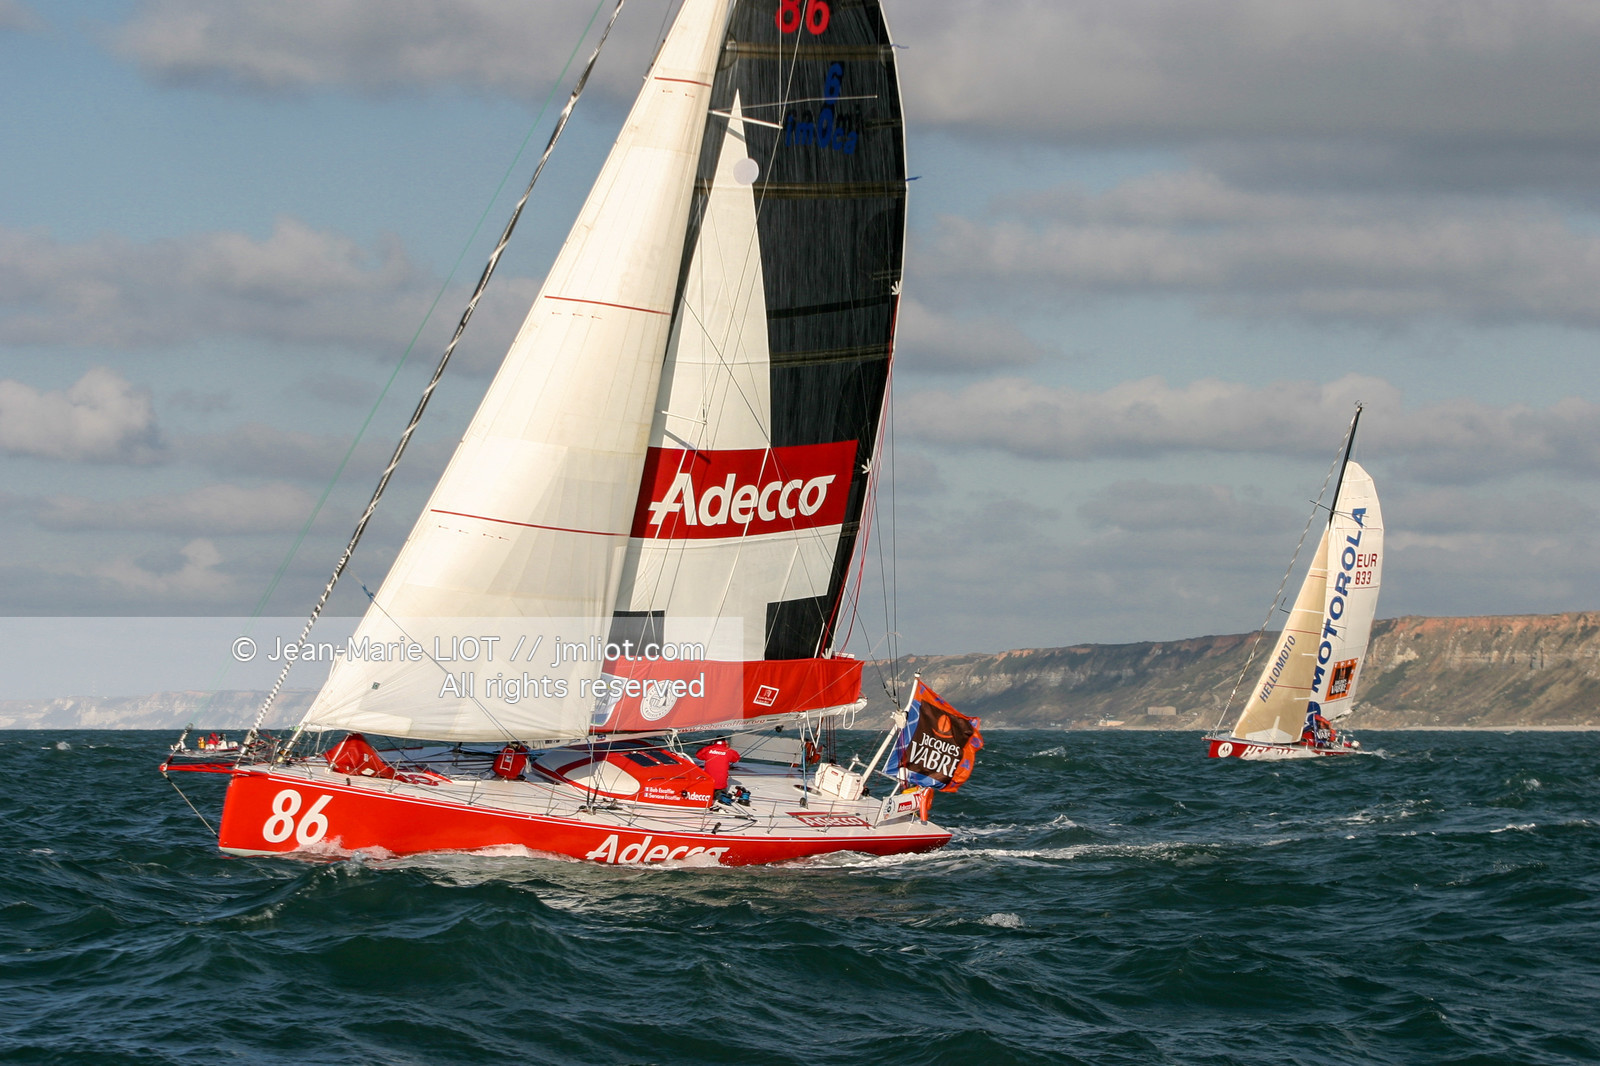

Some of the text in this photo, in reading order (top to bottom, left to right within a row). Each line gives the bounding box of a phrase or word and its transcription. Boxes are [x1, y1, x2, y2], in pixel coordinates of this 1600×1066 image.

[775, 0, 830, 35] 86
[648, 472, 837, 527] Adecco
[1355, 571, 1372, 585] 833
[1356, 553, 1378, 568] EUR
[1311, 507, 1367, 694] MOTOROLA
[1259, 634, 1297, 703] HELLOMOTO
[919, 732, 961, 757] Jacques
[686, 791, 711, 802] Adecco
[262, 788, 334, 846] 86
